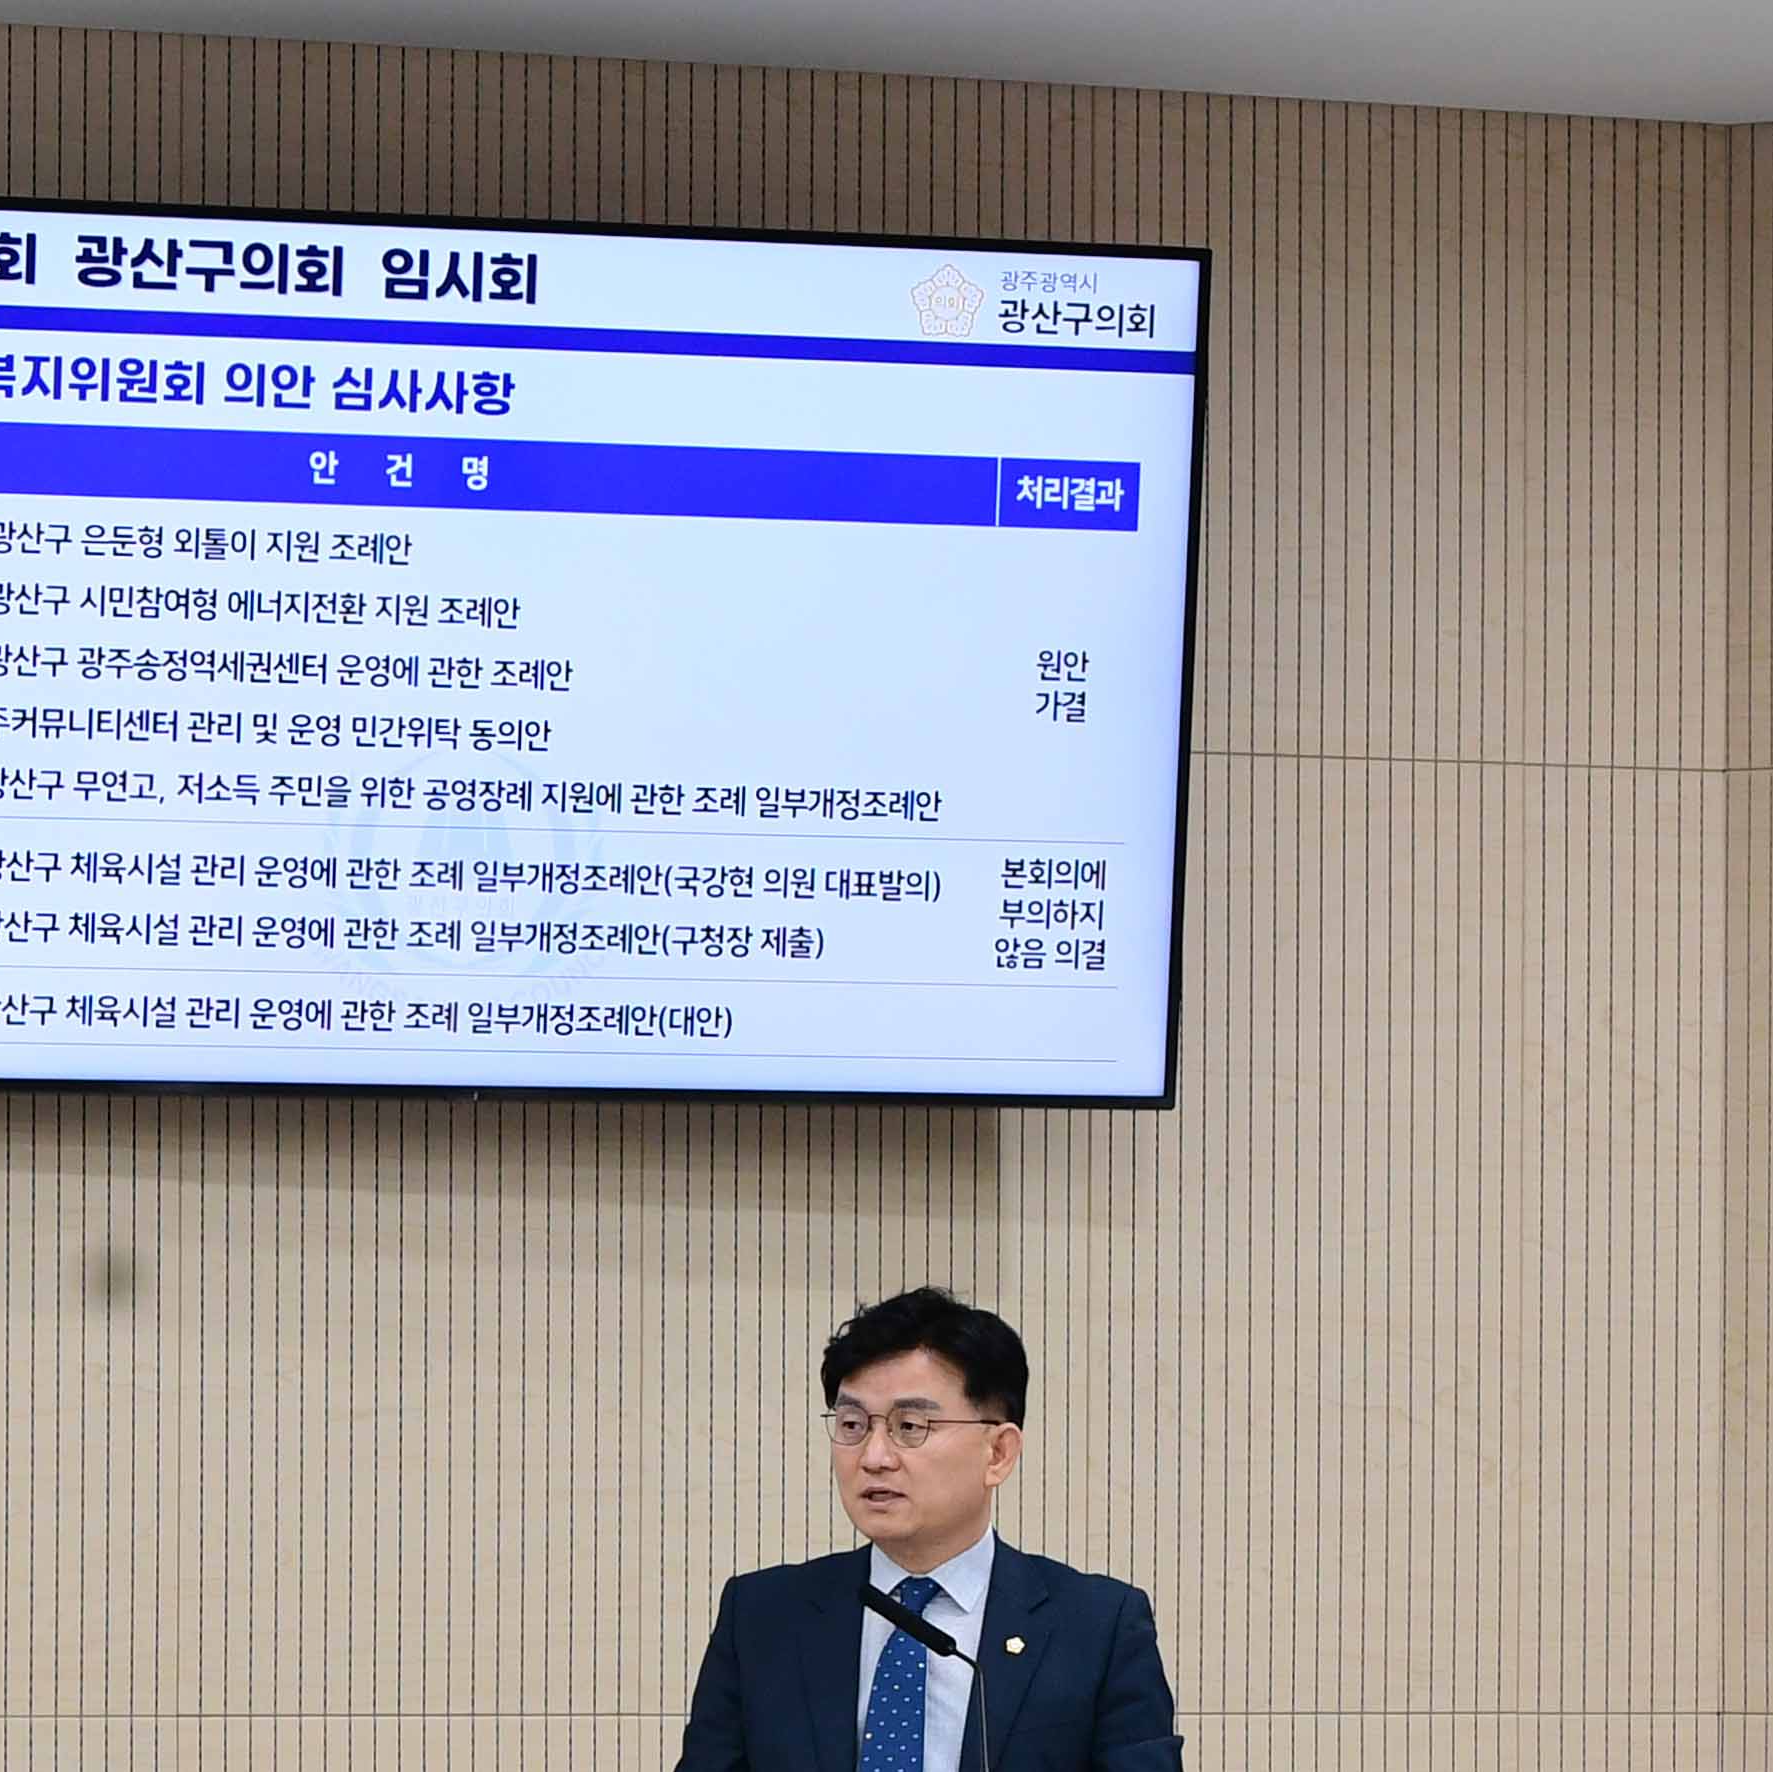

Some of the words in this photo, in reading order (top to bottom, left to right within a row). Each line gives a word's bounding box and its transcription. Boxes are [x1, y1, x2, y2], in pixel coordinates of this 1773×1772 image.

[75, 234, 344, 297] 광산구의회
[381, 247, 538, 305] 임시회
[1000, 270, 1098, 295] 광주광역시
[998, 298, 1155, 339] 광산구의회
[224, 362, 316, 410] 의안
[332, 366, 516, 416] 심사사항
[1016, 475, 1125, 511] 처리결과
[80, 524, 163, 559] 은둔형
[173, 527, 256, 561] 외톨이
[266, 529, 320, 563] 지원
[328, 532, 413, 566] 조례안
[79, 585, 218, 622] 시민참여형
[227, 589, 367, 625] 에너지전환
[375, 593, 429, 627] 지원
[437, 596, 521, 630] 조례안
[77, 646, 328, 685] 광주송정역세권센터
[336, 654, 419, 688] 운영에
[427, 656, 484, 690] 관한
[490, 659, 574, 692] 조례안
[1036, 649, 1090, 683] 원안
[1035, 690, 1086, 723] 가결
[187, 711, 242, 744] 관리
[252, 712, 277, 745] 및
[287, 714, 341, 748] 운영
[352, 715, 462, 750] 민간위탁
[468, 719, 552, 752] 동의안
[73, 770, 165, 804] 무연고,
[177, 772, 261, 806] 저소득
[268, 775, 352, 808] 주민을
[360, 776, 416, 809] 위한
[422, 778, 533, 812] 공영장례
[541, 781, 622, 814] 지원에
[630, 783, 686, 816] 관한
[691, 785, 747, 817] 조례
[755, 786, 943, 822] 일부개정조례안
[70, 851, 181, 886] 체육시설
[190, 854, 245, 887] 관리
[254, 855, 337, 889] 운영에
[345, 857, 402, 891] 관한
[408, 860, 464, 892] 조례
[473, 860, 754, 898] 일부개정조례안(국강현
[763, 867, 816, 900] 의원
[825, 868, 941, 903] 대표발의)
[1000, 858, 1107, 891] 본회의에
[999, 898, 1104, 931] 부의하지
[68, 911, 179, 947] 체육시설
[188, 914, 243, 947] 관리
[251, 916, 335, 949] 운영에
[343, 917, 399, 950] 관한
[406, 919, 461, 952] 조례
[470, 920, 754, 958] 일부개정조례안(구청장
[760, 925, 824, 960] 제출)
[994, 937, 1047, 969] 않음
[1054, 938, 1106, 971] 의결
[65, 994, 176, 1029] 체육시설
[185, 996, 240, 1030] 관리
[249, 998, 332, 1032] 운영에
[340, 999, 397, 1032] 관한
[403, 1001, 459, 1033] 조례
[467, 1002, 733, 1039] 일부개정조례안(대안)
